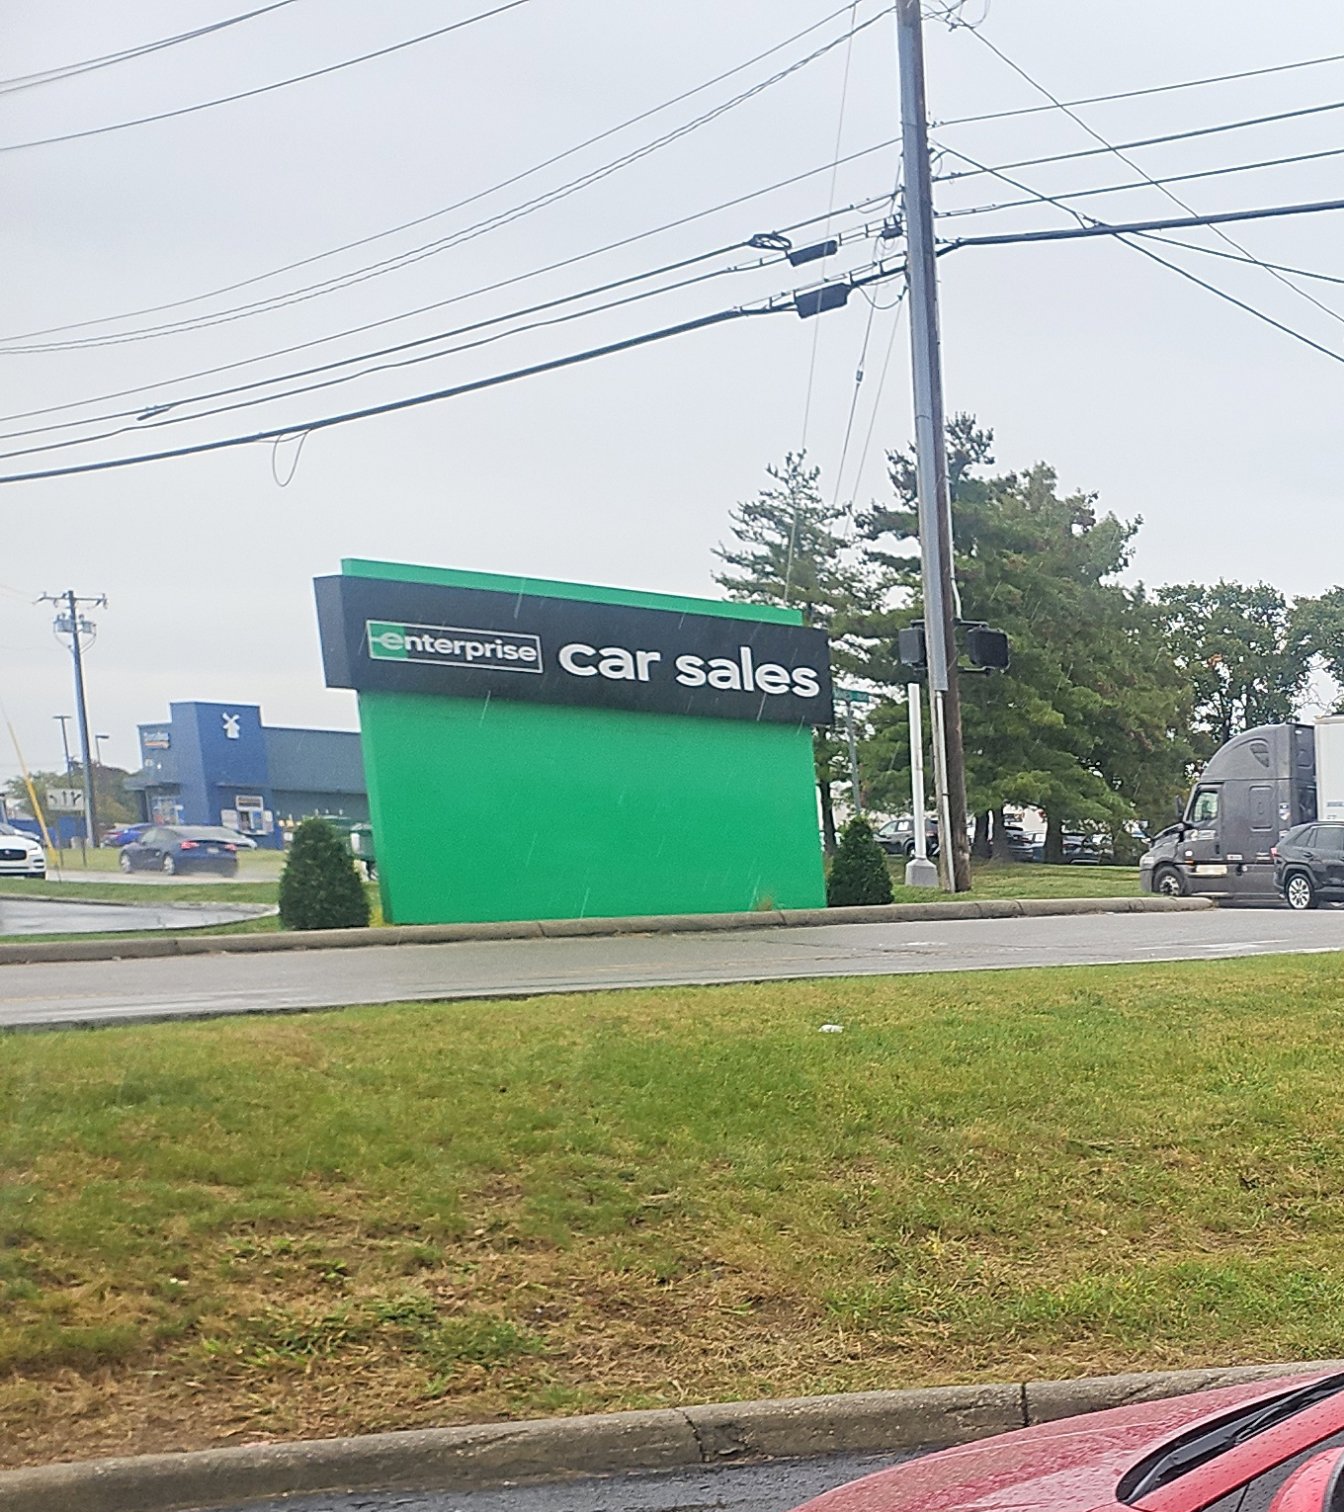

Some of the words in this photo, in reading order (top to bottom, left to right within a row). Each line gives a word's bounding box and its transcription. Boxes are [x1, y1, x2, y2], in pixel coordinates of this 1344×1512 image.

[374, 631, 537, 661] enterprise
[558, 643, 661, 682] car
[675, 646, 820, 698] sales
